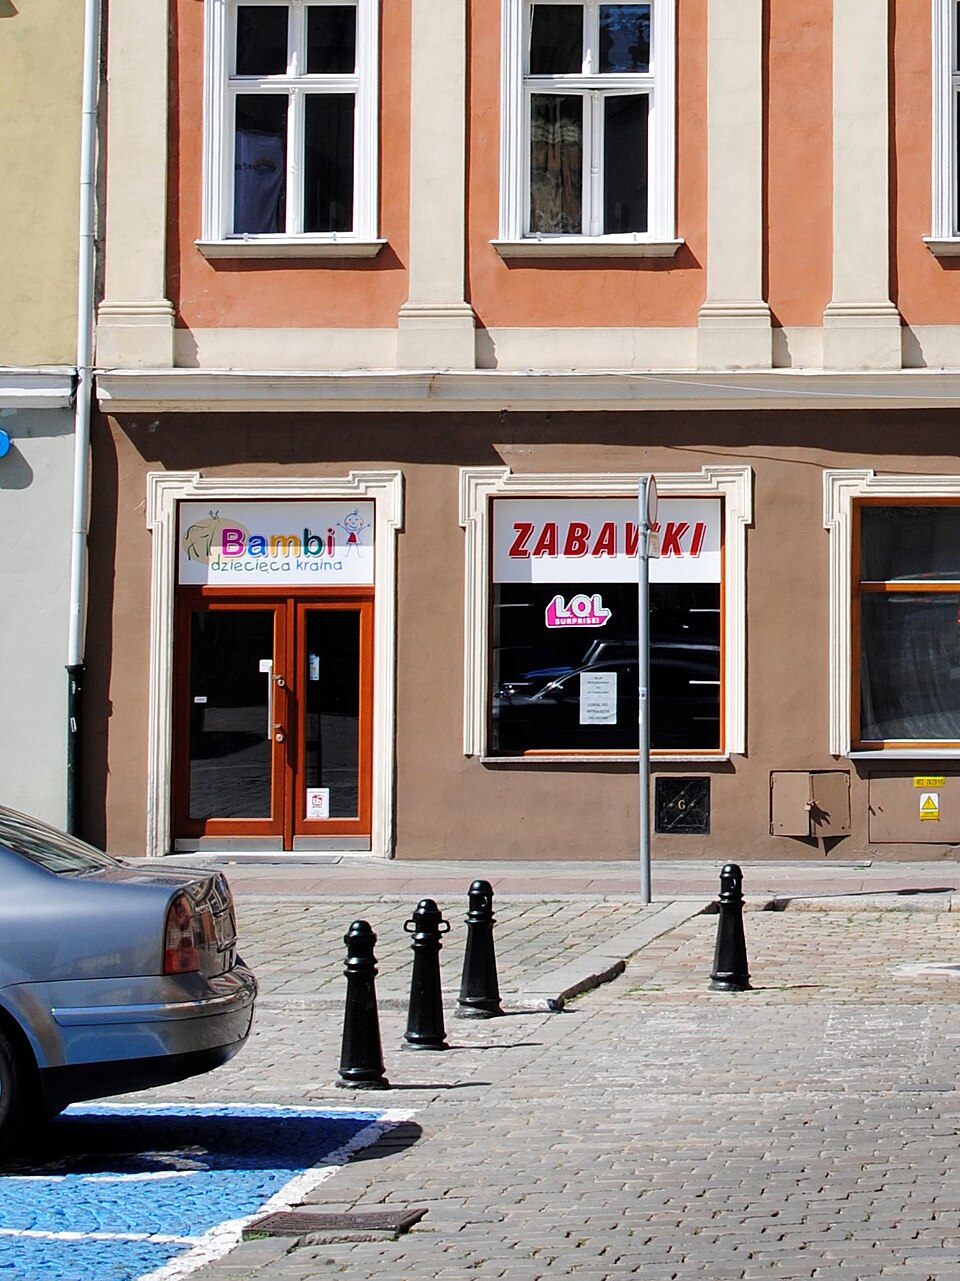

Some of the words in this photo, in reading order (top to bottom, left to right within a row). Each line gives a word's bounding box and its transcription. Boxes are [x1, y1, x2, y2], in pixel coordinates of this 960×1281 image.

[221, 527, 336, 558] Bambi
[211, 554, 291, 573] dziecięca
[296, 558, 343, 571] kraina
[677, 799, 686, 810] G
